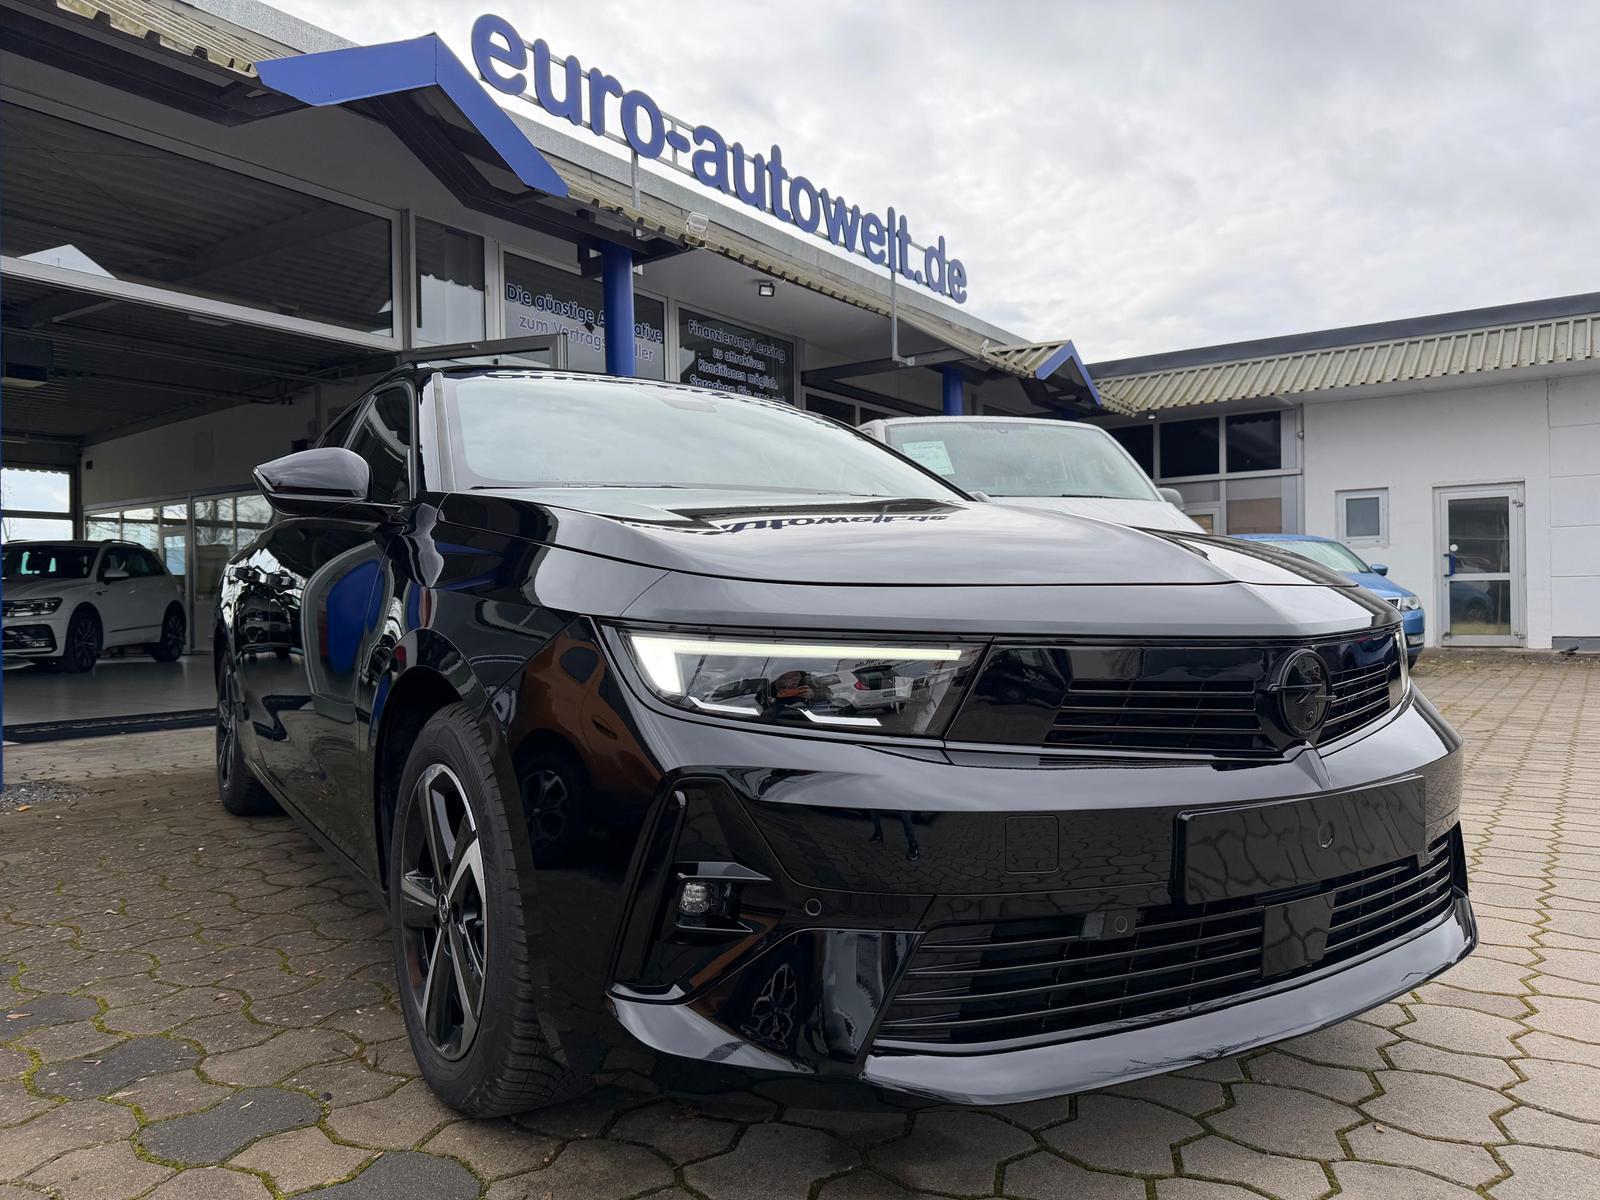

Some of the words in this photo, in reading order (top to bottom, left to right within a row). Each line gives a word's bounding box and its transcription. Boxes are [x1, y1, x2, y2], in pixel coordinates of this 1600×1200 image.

[470, 13, 968, 304] euro-autowelt.de
[506, 282, 532, 306] Die
[535, 294, 595, 325] günstige
[519, 314, 549, 334] zum
[698, 358, 747, 382] Konditionen
[712, 347, 724, 360] zu
[724, 351, 766, 371] attraktiven
